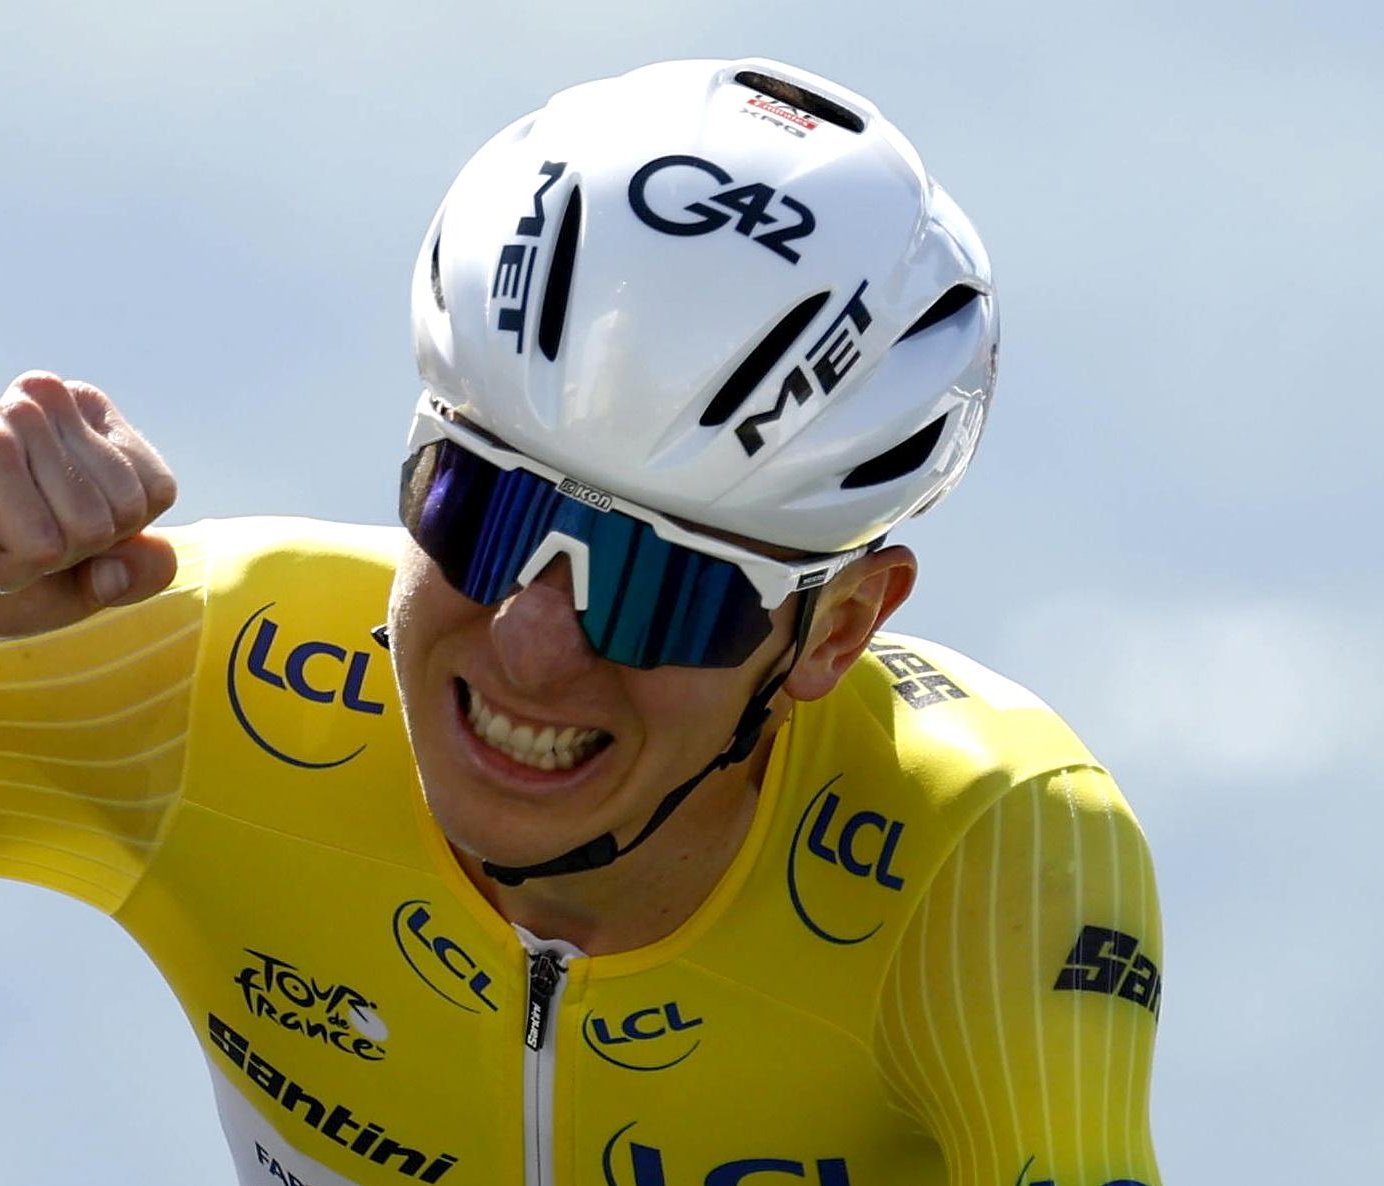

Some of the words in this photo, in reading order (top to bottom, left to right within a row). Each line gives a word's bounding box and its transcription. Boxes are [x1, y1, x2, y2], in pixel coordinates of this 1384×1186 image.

[492, 160, 568, 354] MET
[628, 155, 816, 265] G42
[734, 279, 873, 457] MET
[247, 617, 385, 715] LCL
[807, 791, 906, 891] LCL
[407, 907, 499, 1012] LCL
[328, 1012, 351, 1030] de
[590, 1001, 703, 1046] LCL
[208, 1012, 459, 1185] Santini
